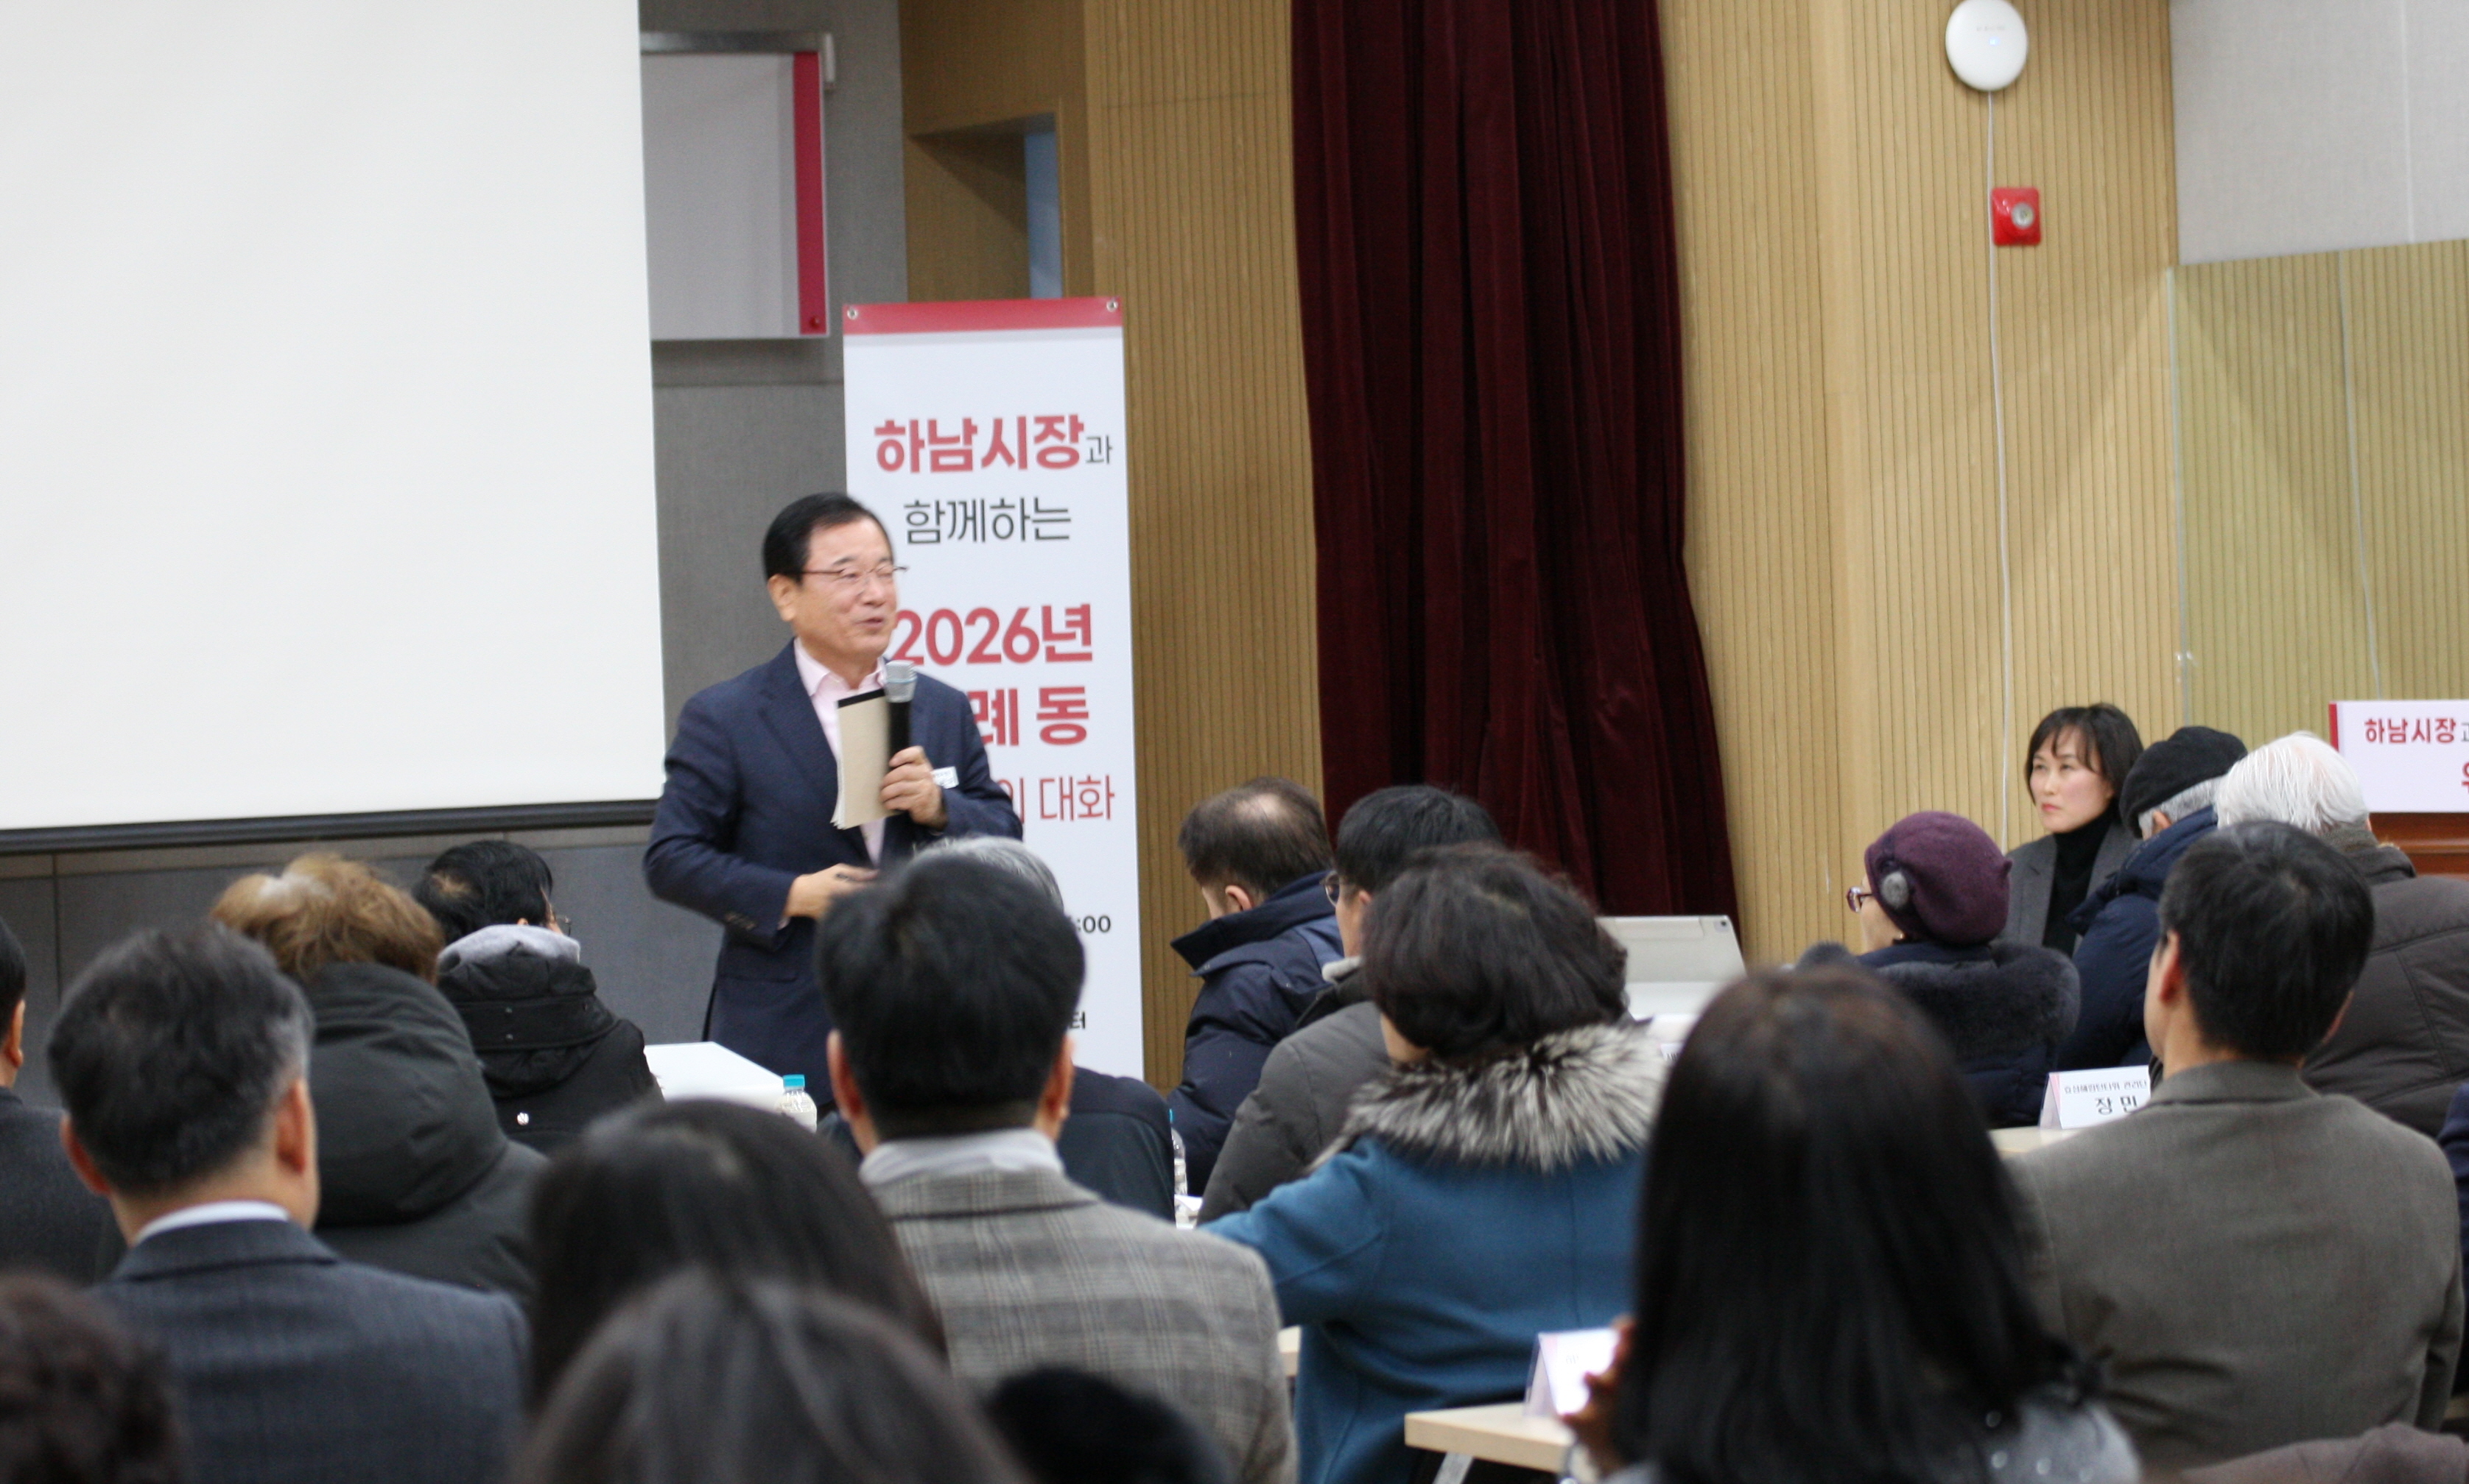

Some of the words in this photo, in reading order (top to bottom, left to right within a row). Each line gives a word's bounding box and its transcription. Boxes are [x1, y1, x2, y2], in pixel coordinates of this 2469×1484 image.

[904, 497, 1072, 545] 함께하는
[888, 603, 1093, 666] 2026년
[1039, 774, 1115, 822] 대화
[1070, 915, 1111, 933] :00
